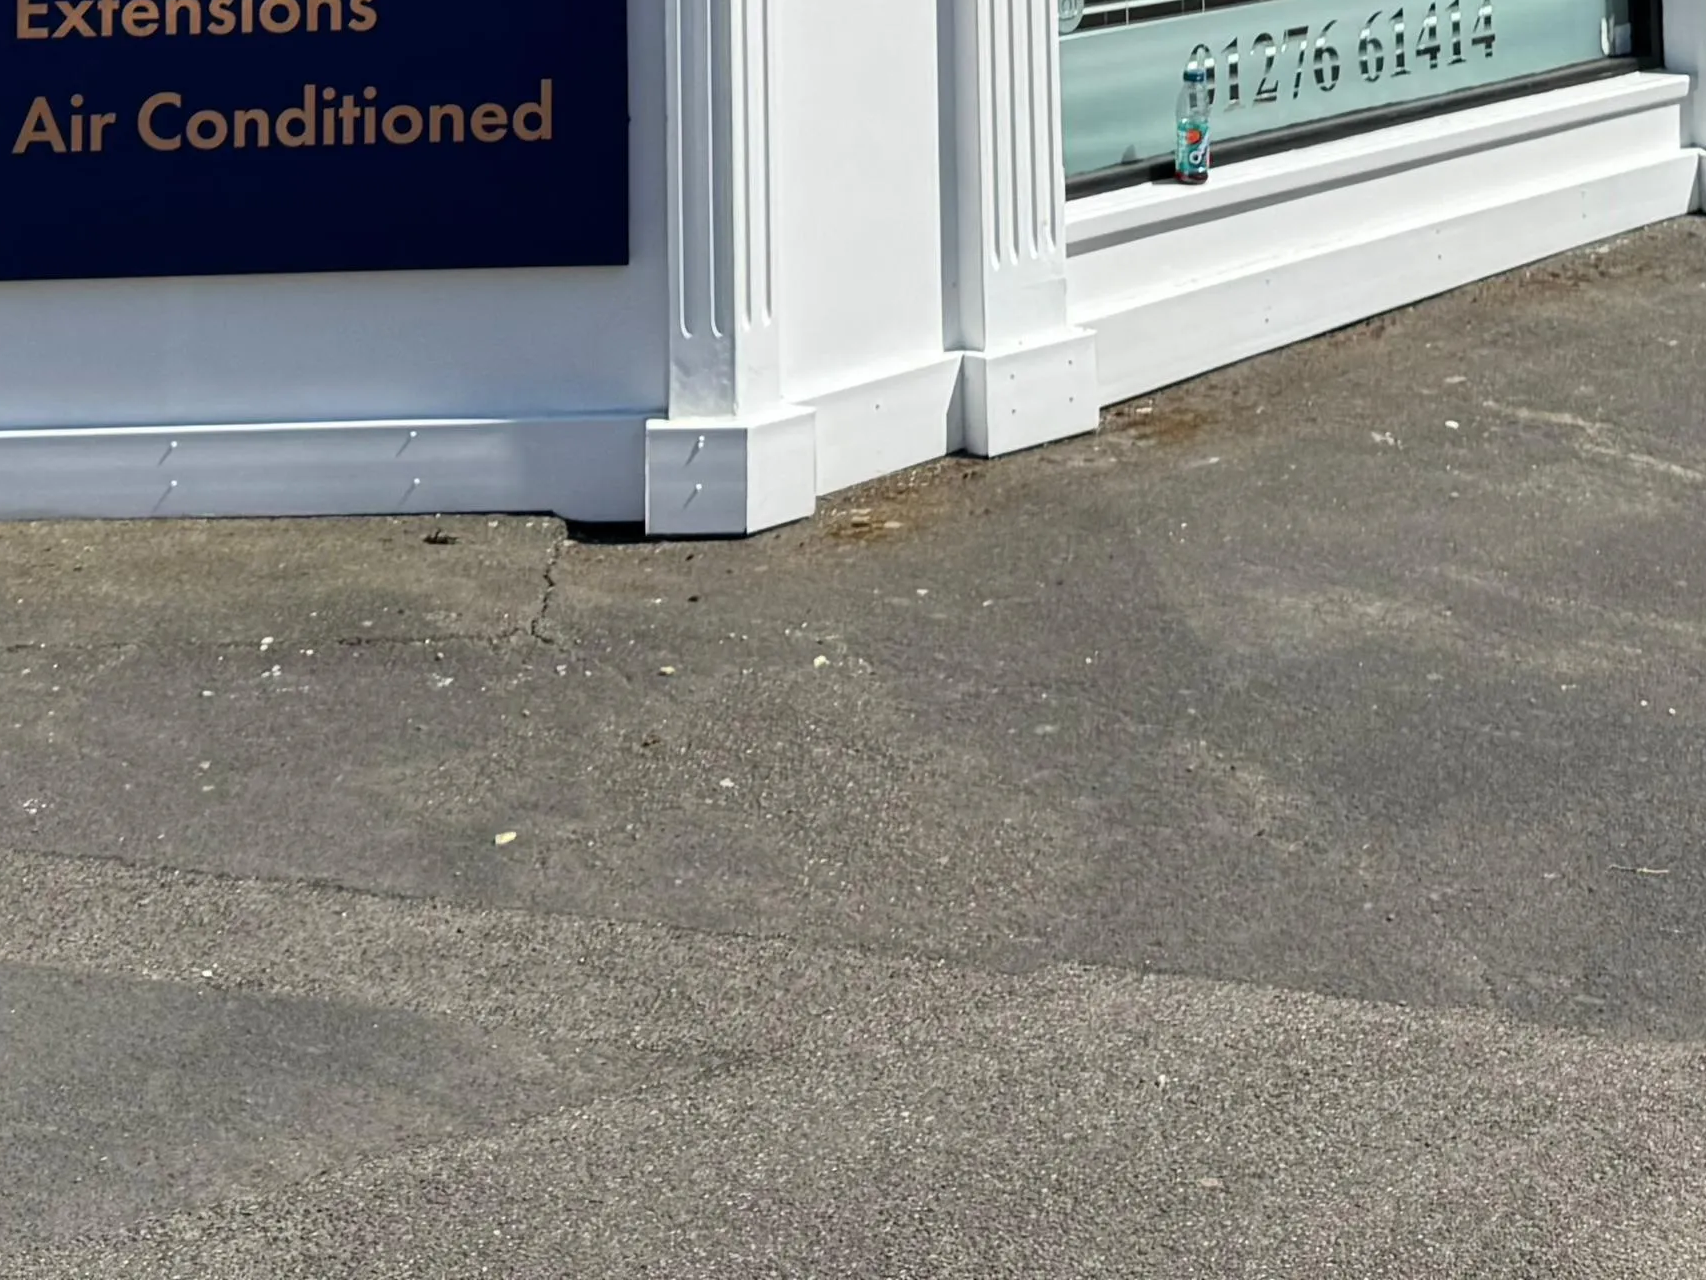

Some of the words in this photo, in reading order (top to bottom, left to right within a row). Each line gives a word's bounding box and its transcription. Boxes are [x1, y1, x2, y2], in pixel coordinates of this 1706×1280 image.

[1188, 19, 1341, 111] 01276
[12, 95, 116, 155] Air
[137, 78, 554, 151] Conditioned
